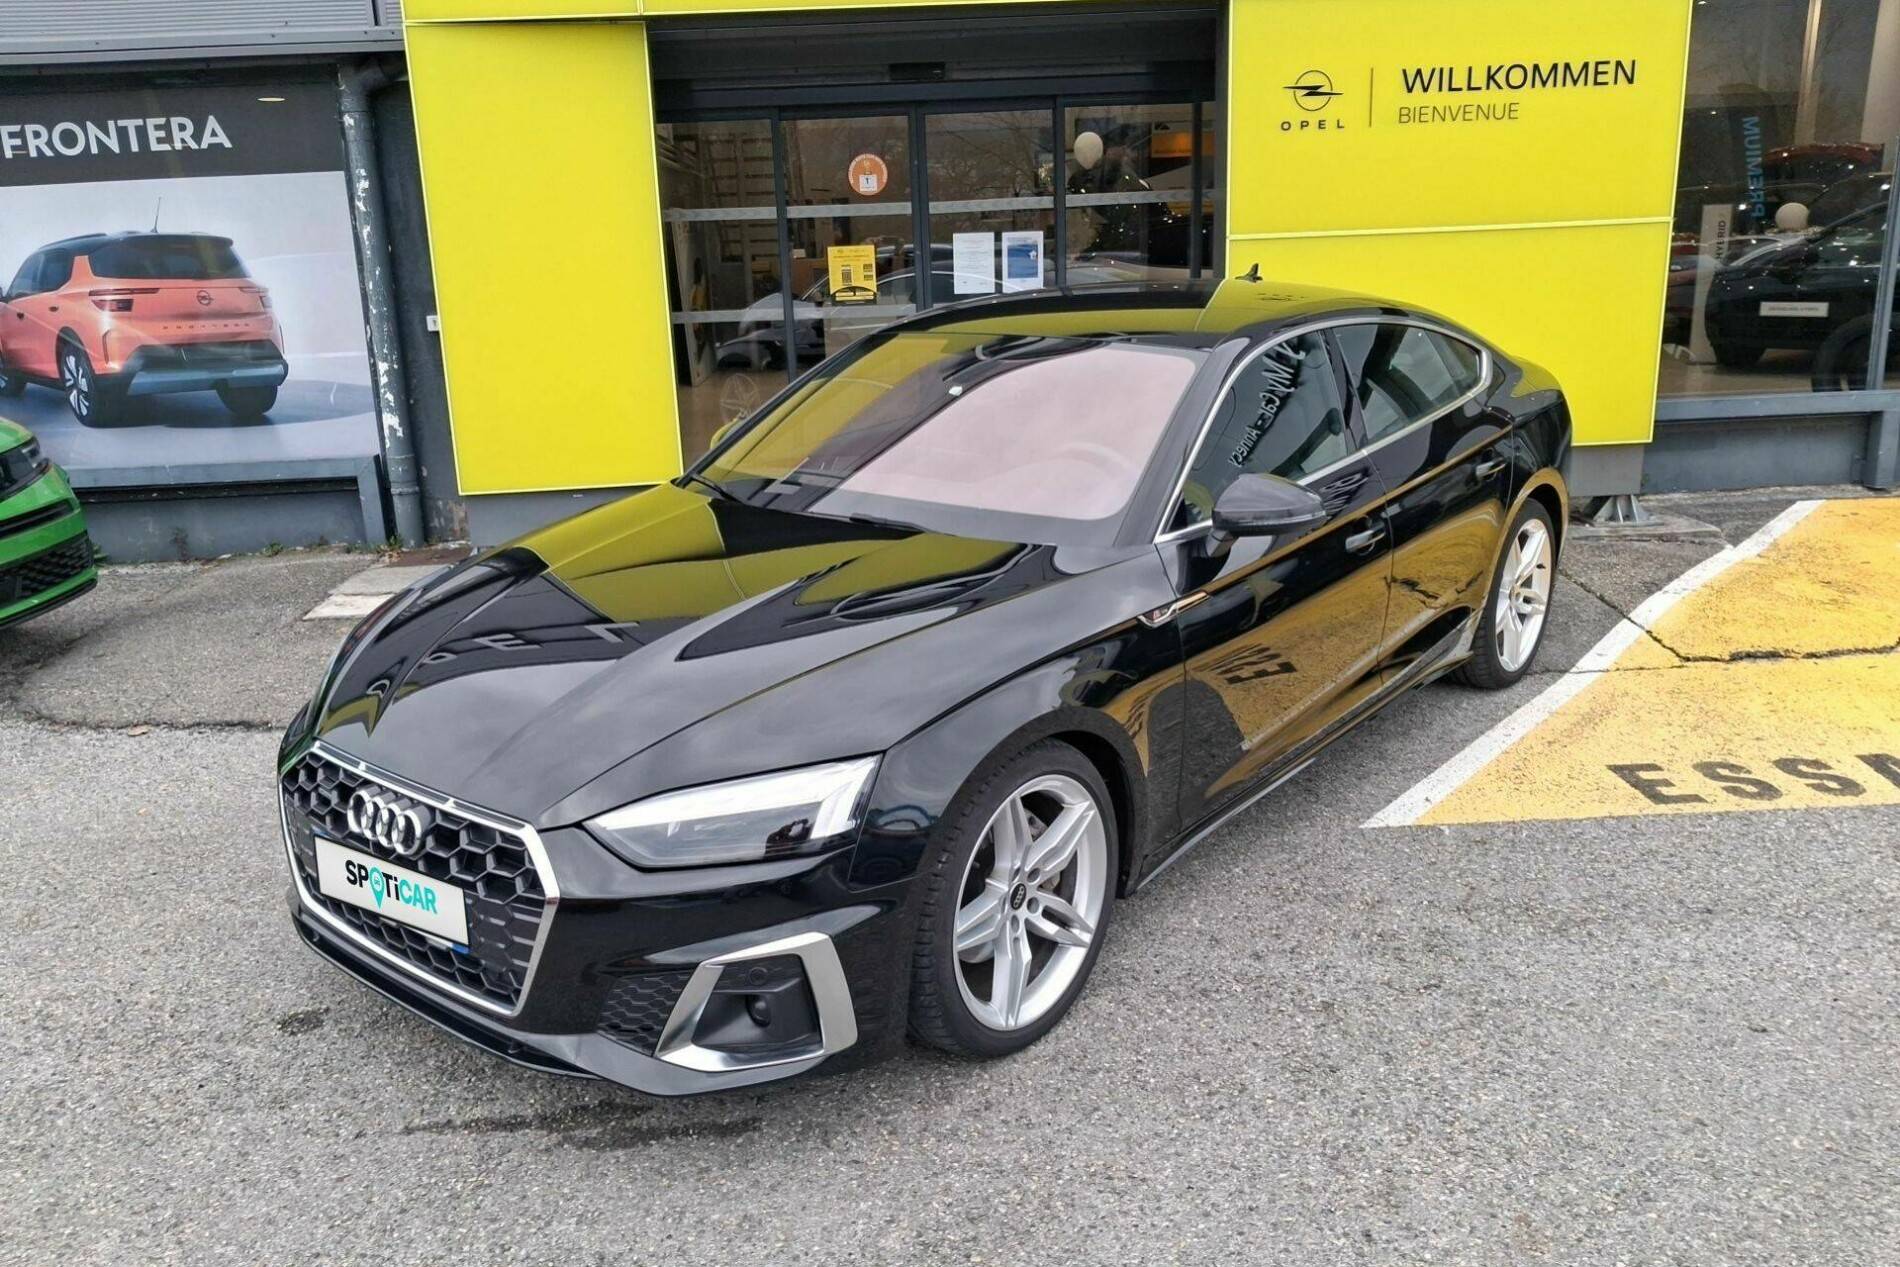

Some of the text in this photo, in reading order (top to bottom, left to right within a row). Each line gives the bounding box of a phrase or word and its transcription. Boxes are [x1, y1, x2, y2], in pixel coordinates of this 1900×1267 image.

[1401, 59, 1637, 94] WILLKOMMEN
[1280, 118, 1345, 131] OPEL
[1398, 102, 1520, 124] BIENVENUE
[0, 115, 233, 159] FRONTERA
